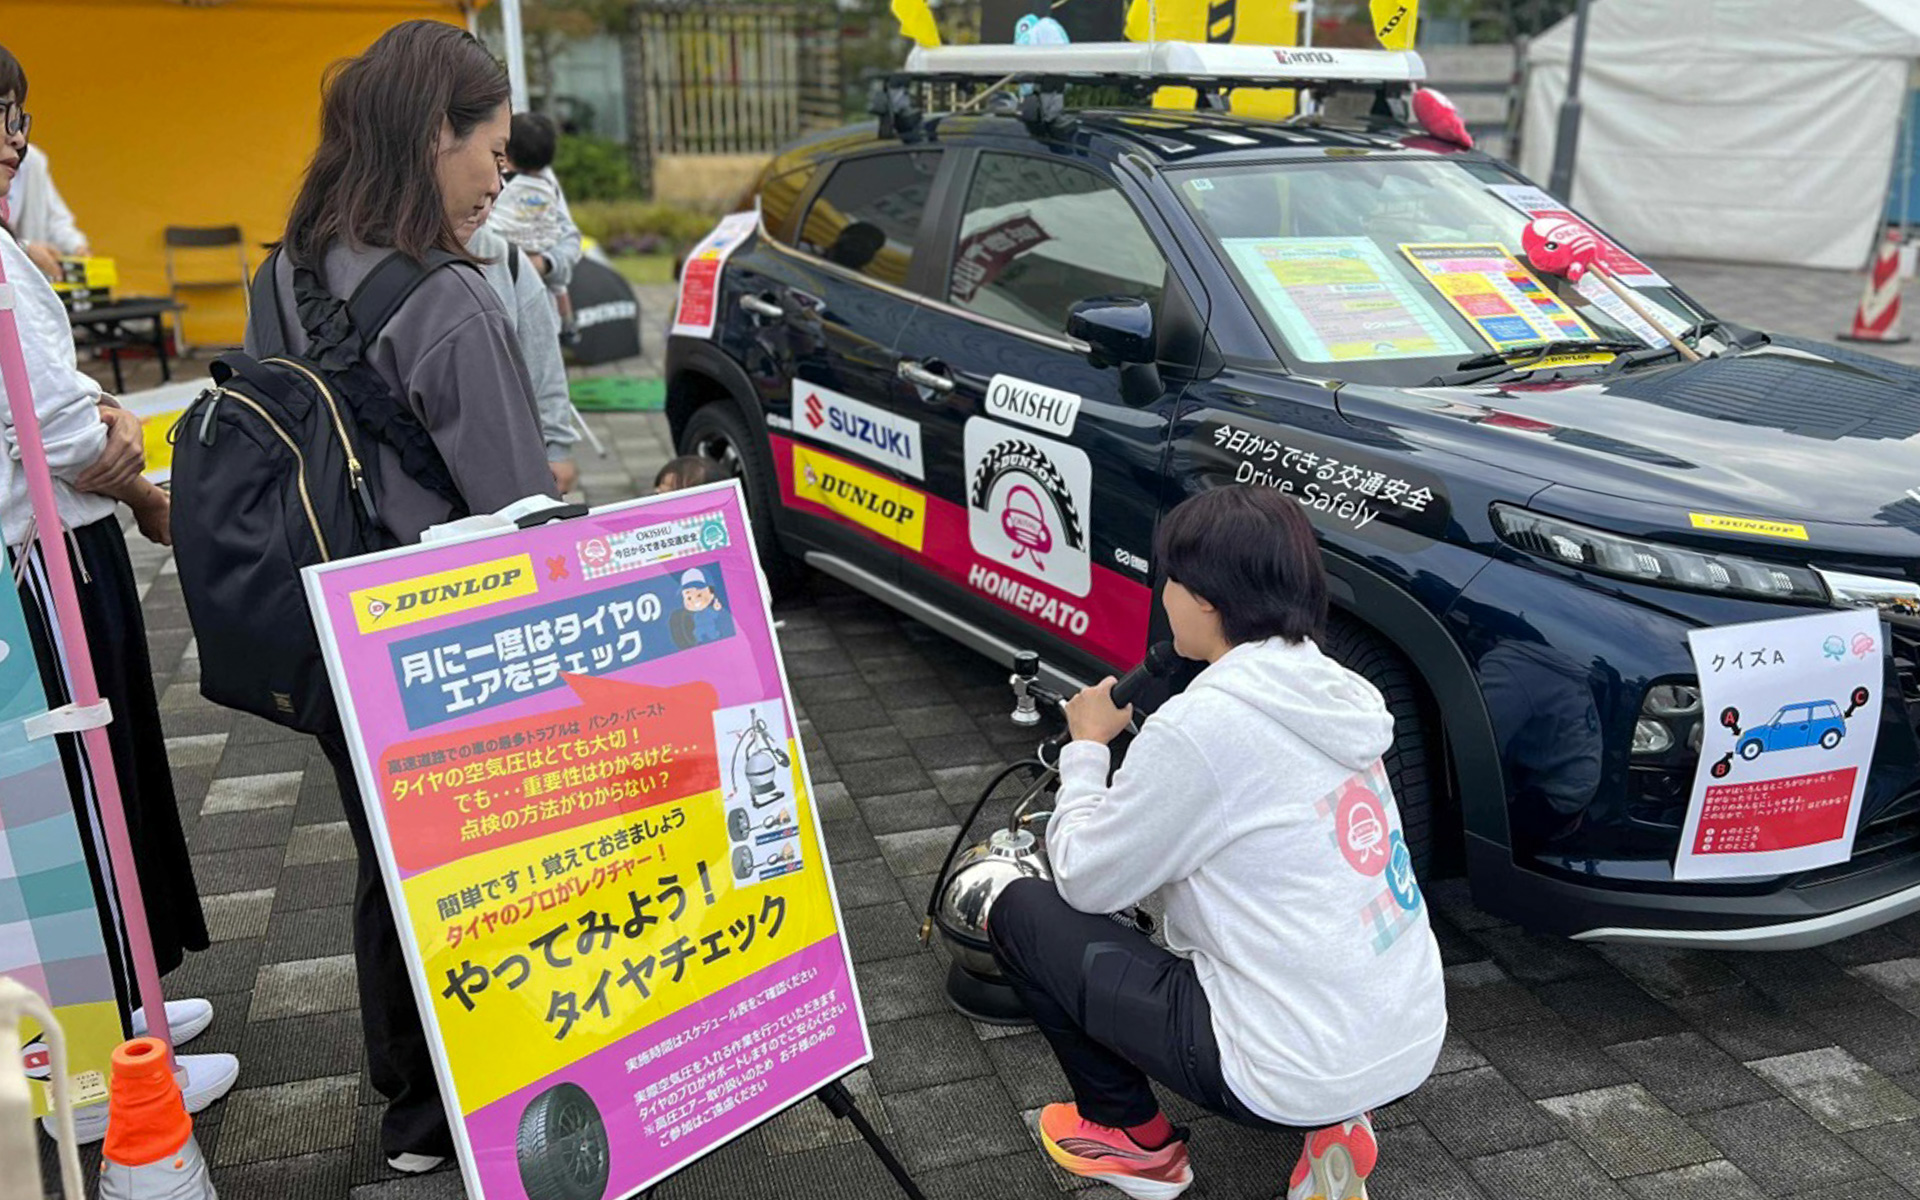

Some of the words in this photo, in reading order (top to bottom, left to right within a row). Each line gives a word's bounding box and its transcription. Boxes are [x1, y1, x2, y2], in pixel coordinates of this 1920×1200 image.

[828, 406, 912, 460] SUZUKI
[993, 383, 1073, 427] OKISHU
[820, 472, 915, 525] DUNLOP
[1001, 455, 1058, 491] DUNLOP
[1213, 424, 1434, 512] 今日からできる交通安全
[1235, 461, 1294, 496] Drive
[1299, 483, 1379, 530] Safely
[614, 532, 698, 559] 今日からできる交通安全
[635, 526, 672, 541] OKISHU
[1719, 520, 1795, 534] DUNLOP
[395, 568, 521, 612] DUNLOP
[968, 563, 1090, 636] HOMEPATO
[401, 593, 662, 689] 月に一度はタイヤの
[441, 630, 643, 713] エアをチェック
[1725, 711, 1735, 723] A
[1855, 691, 1865, 702] C
[391, 728, 640, 801] タイヤの空気圧はとても大切！
[1717, 763, 1726, 774] B
[460, 773, 670, 842] 点検の方法がわからない？
[437, 807, 686, 921] 簡単です！覚えておきましょう
[446, 844, 666, 949] タイヤのプロがレクチャー！
[441, 860, 716, 1012] やってみよう！
[544, 895, 786, 1041] タイヤチェック
